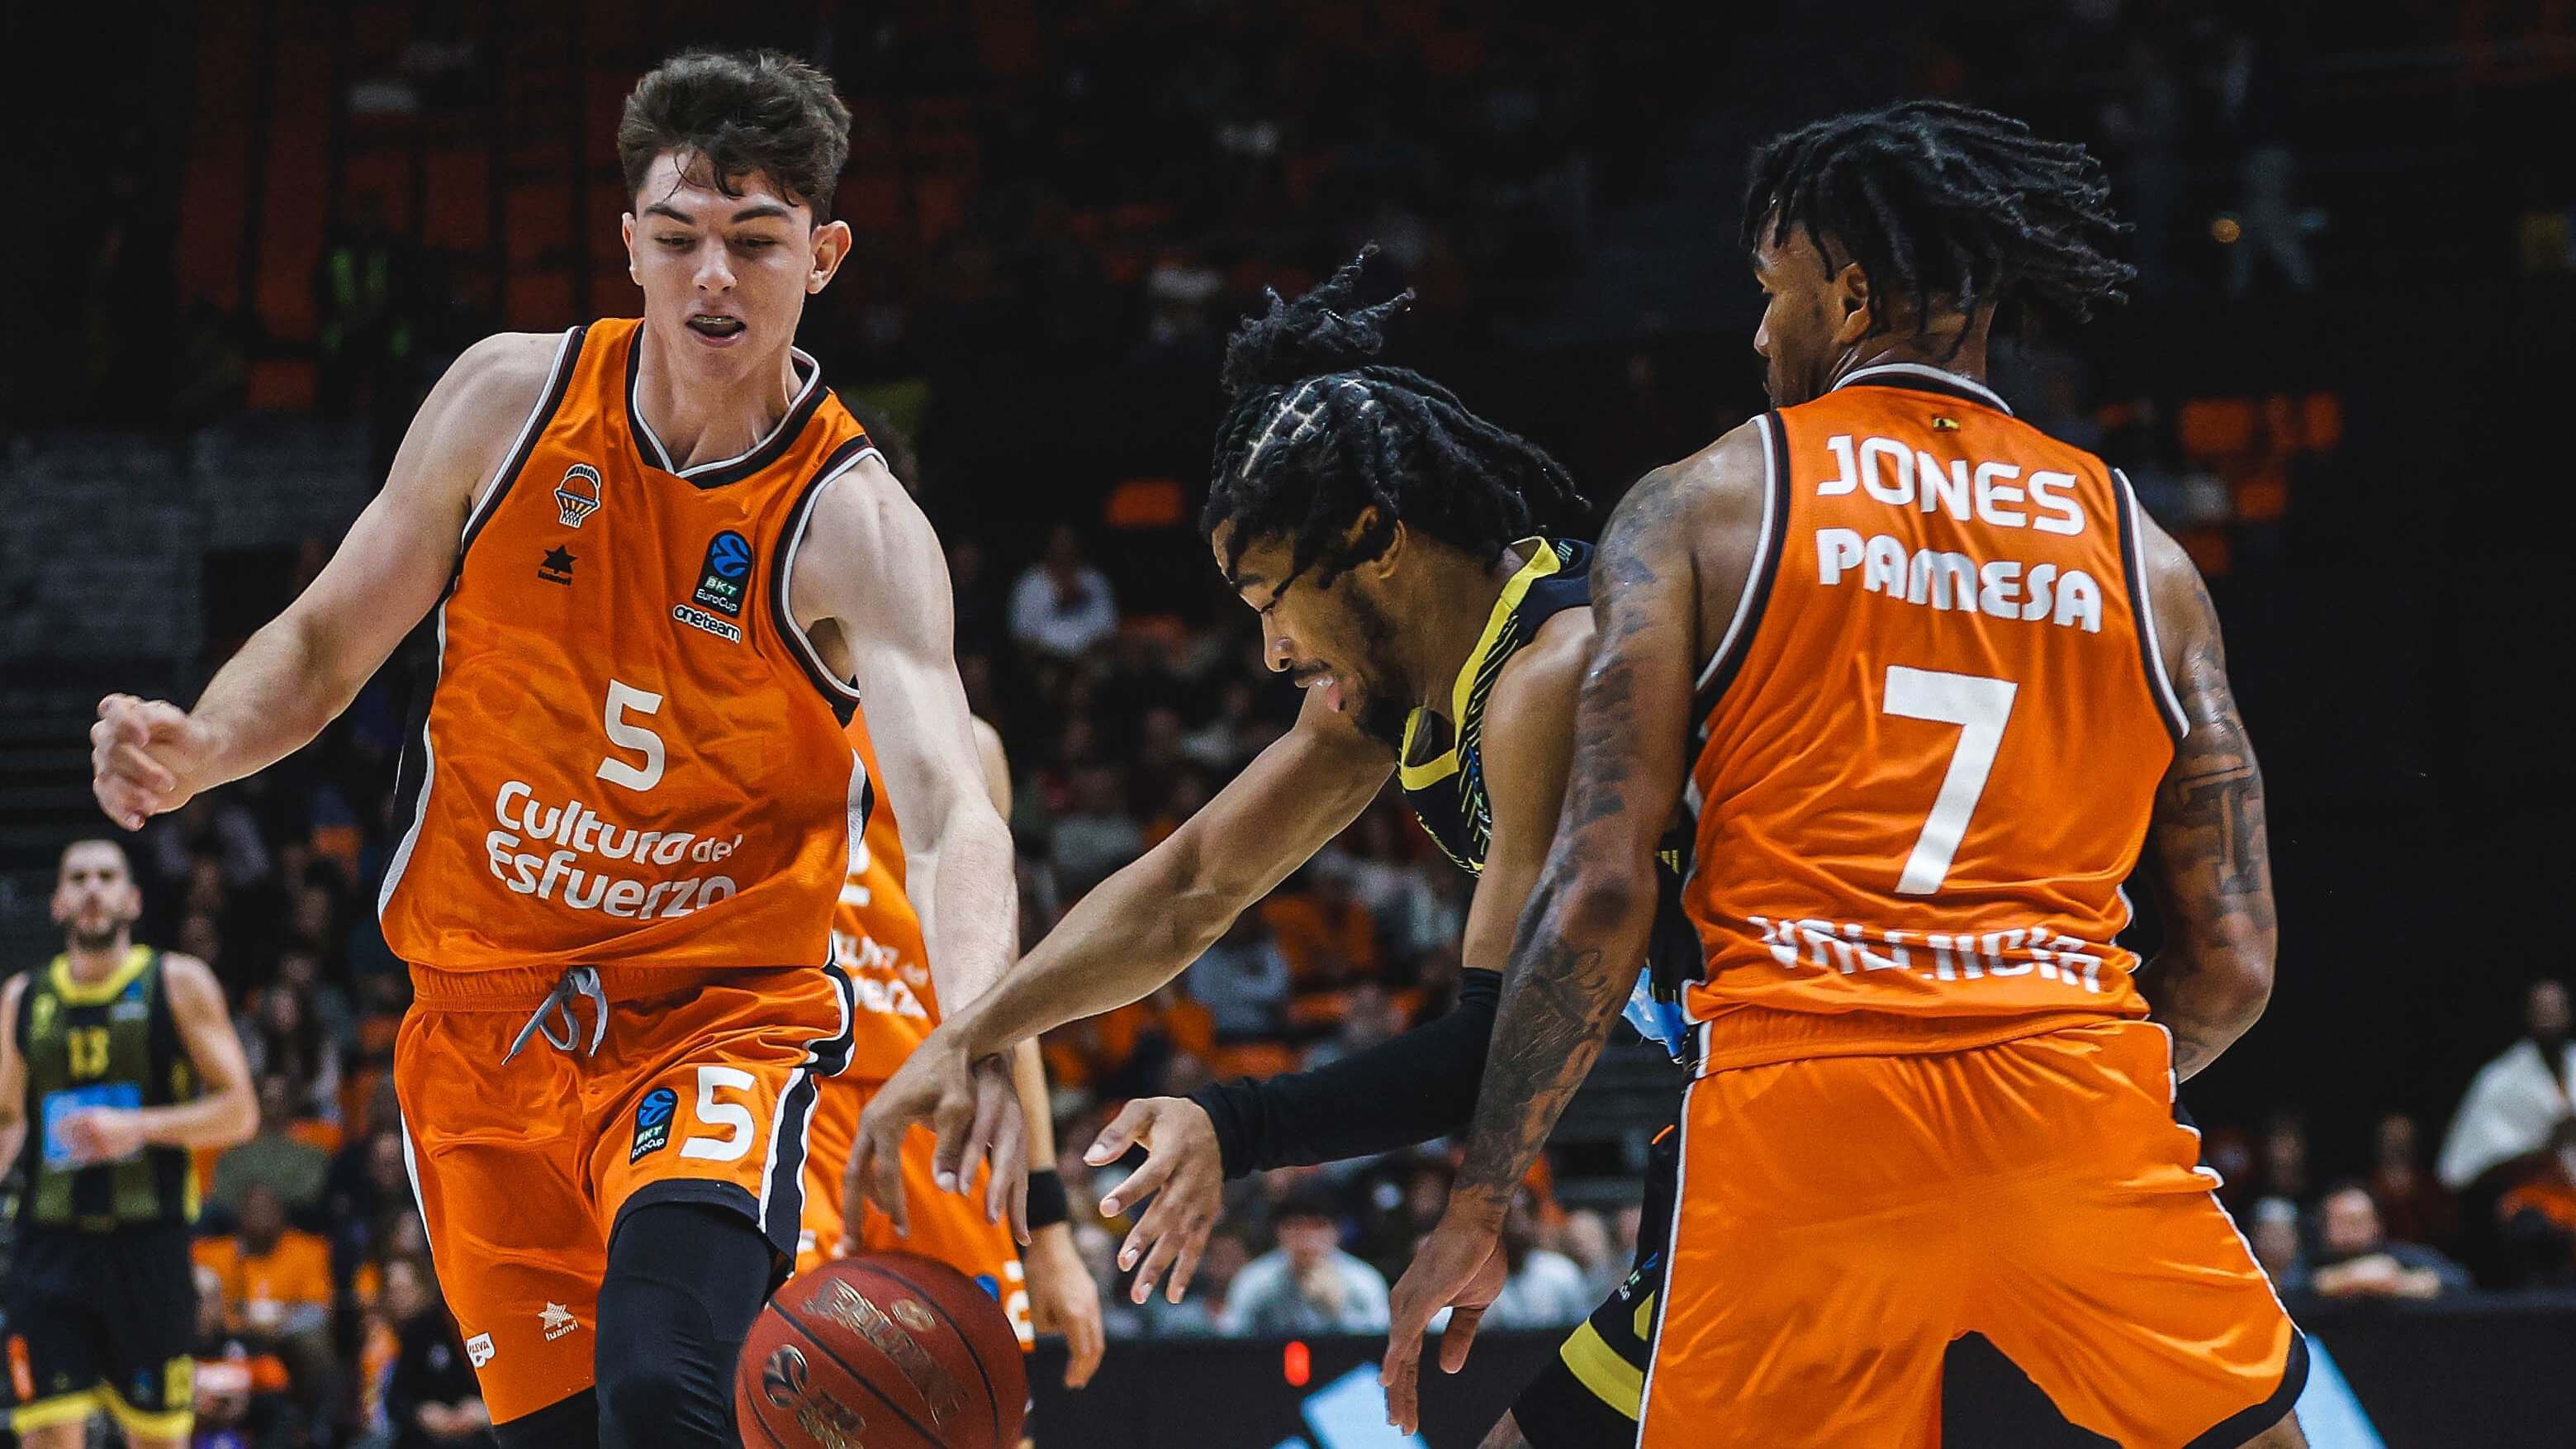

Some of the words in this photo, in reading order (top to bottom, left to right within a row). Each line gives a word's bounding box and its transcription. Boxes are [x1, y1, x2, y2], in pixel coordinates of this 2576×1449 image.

[1816, 435, 2086, 536] JONES
[673, 605, 741, 643] oneteam
[696, 588, 738, 613] EuroCup
[704, 576, 738, 595] BKT
[1815, 527, 2102, 634] PAMESA
[595, 677, 667, 792] 5
[1882, 665, 2019, 895] 7
[496, 781, 695, 865] Cultura
[486, 830, 737, 920] Esfuerzo
[679, 1065, 756, 1162] 5
